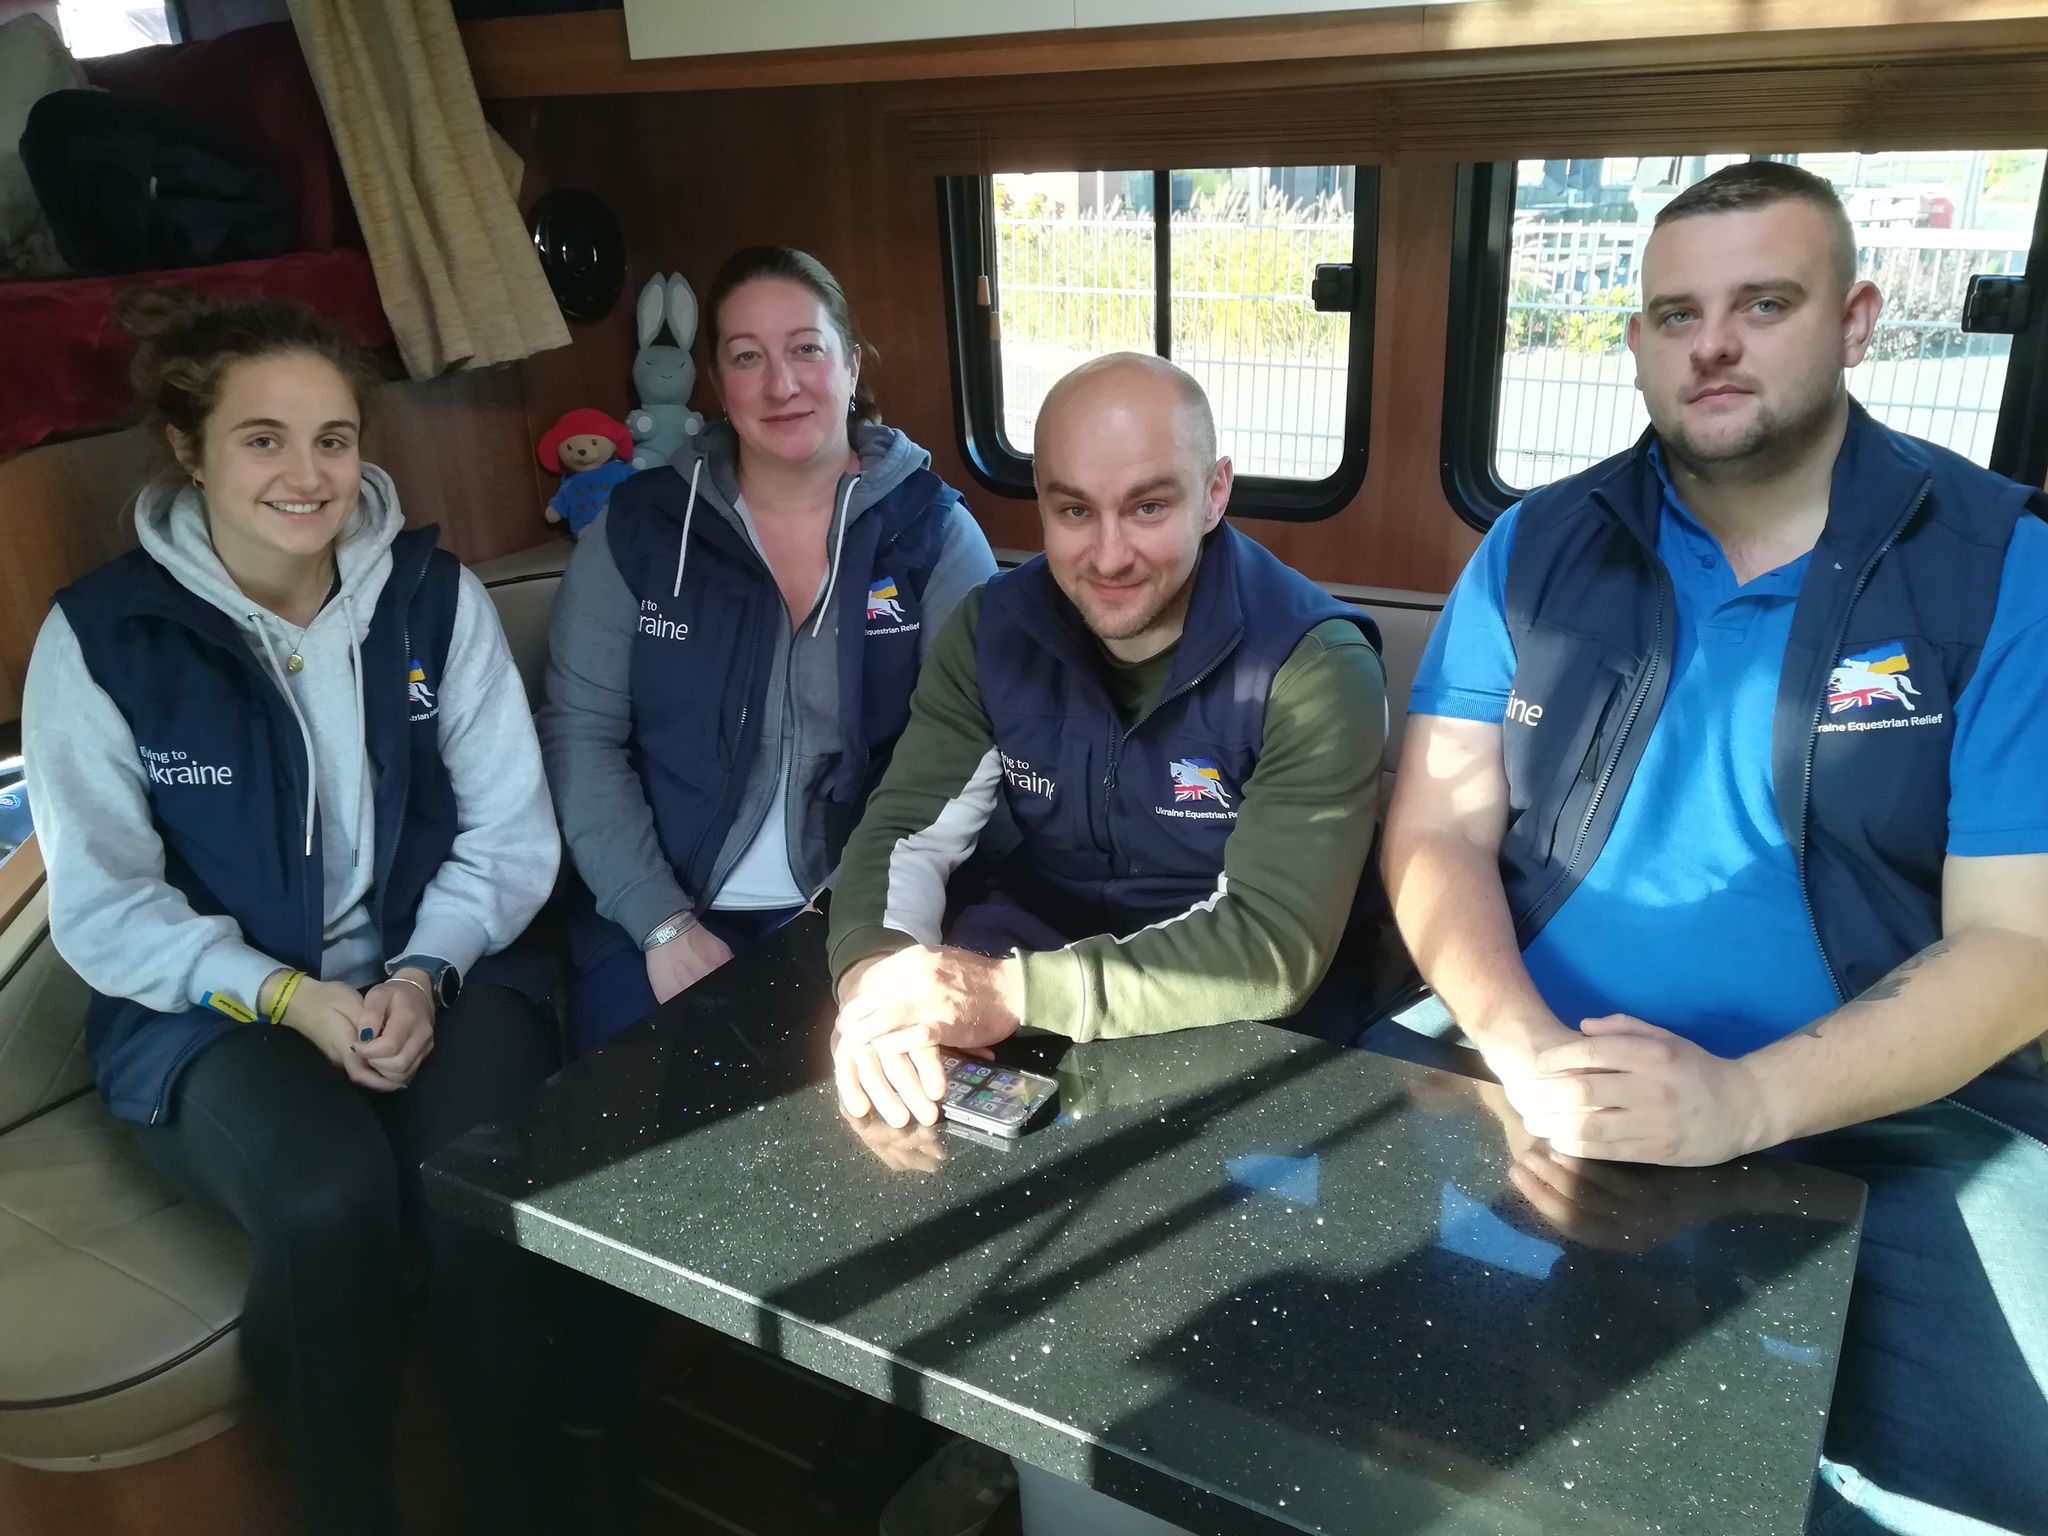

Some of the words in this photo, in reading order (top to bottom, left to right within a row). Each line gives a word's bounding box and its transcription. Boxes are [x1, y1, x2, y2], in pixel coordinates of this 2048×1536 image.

[647, 600, 657, 611] to
[638, 613, 689, 641] raine
[900, 621, 920, 632] Relief
[1817, 723, 1846, 733] raine
[1848, 718, 1909, 732] Equestrian
[1911, 713, 1943, 726] Relief
[171, 750, 187, 760] to
[1016, 759, 1030, 769] to
[1155, 805, 1184, 818] Ukraine
[1185, 810, 1228, 819] Equestrian
